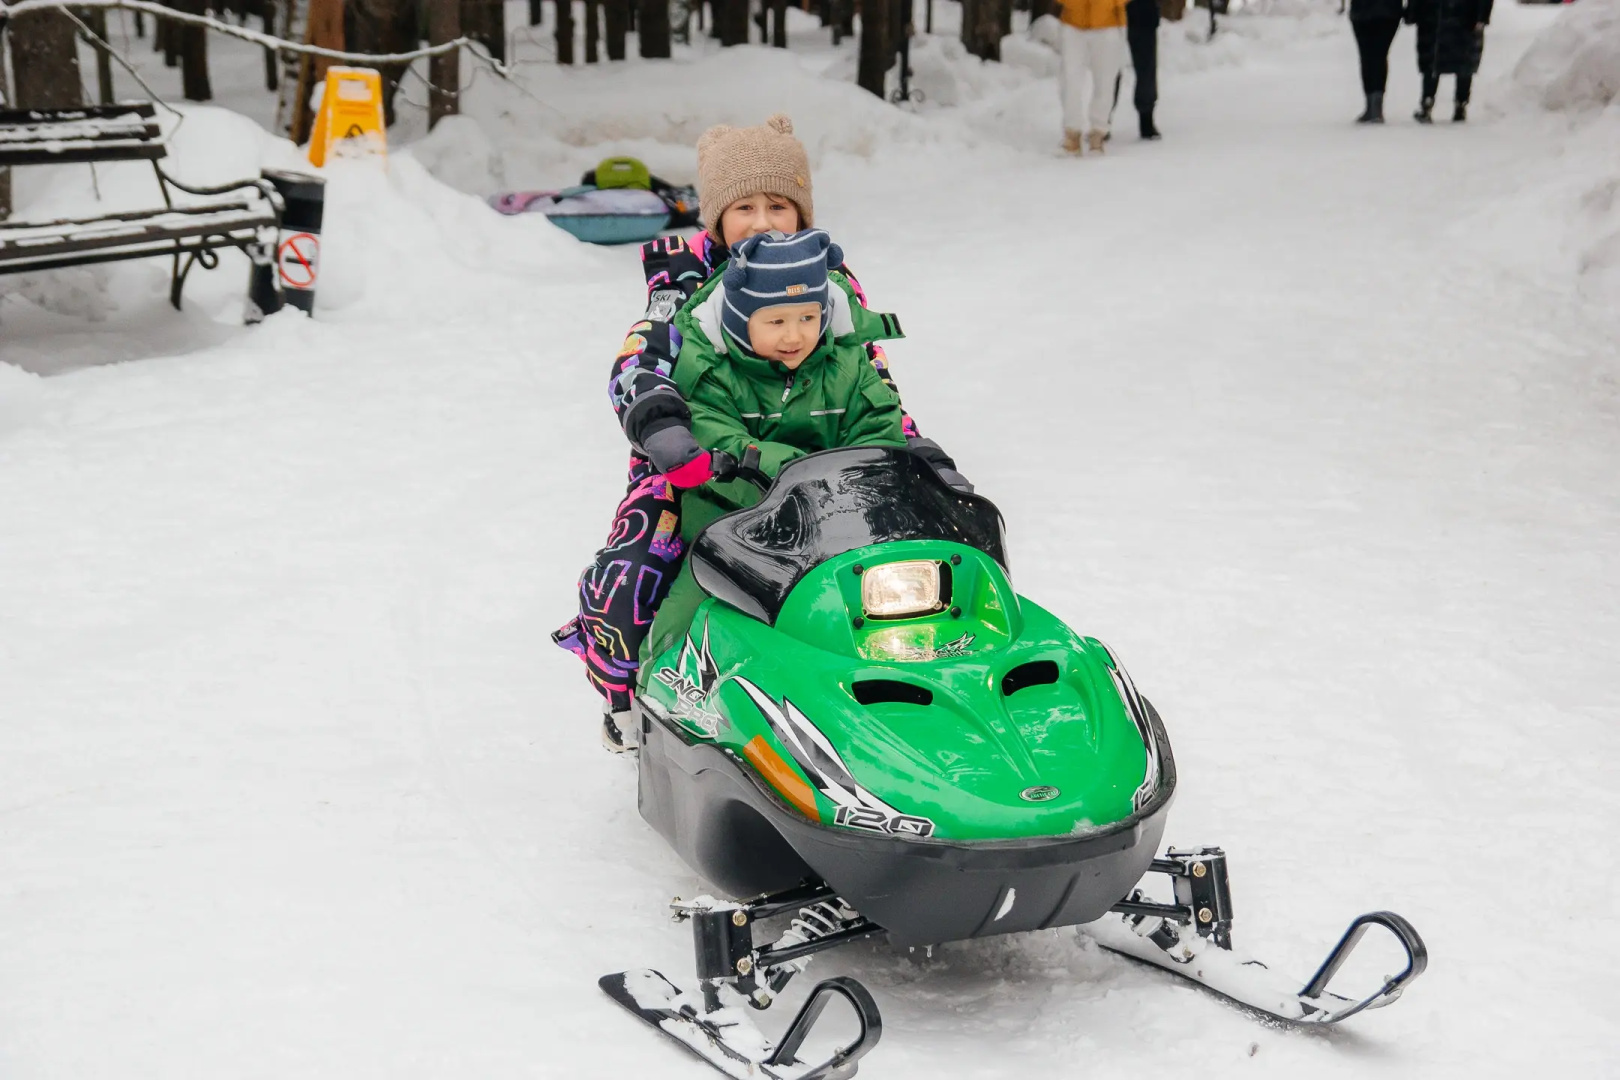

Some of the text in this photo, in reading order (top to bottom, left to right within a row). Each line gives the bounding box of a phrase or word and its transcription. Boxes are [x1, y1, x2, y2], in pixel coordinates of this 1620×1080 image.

[655, 294, 672, 302] SKI
[653, 667, 707, 703] SNO
[672, 699, 718, 731] PRO
[833, 806, 936, 838] 120
